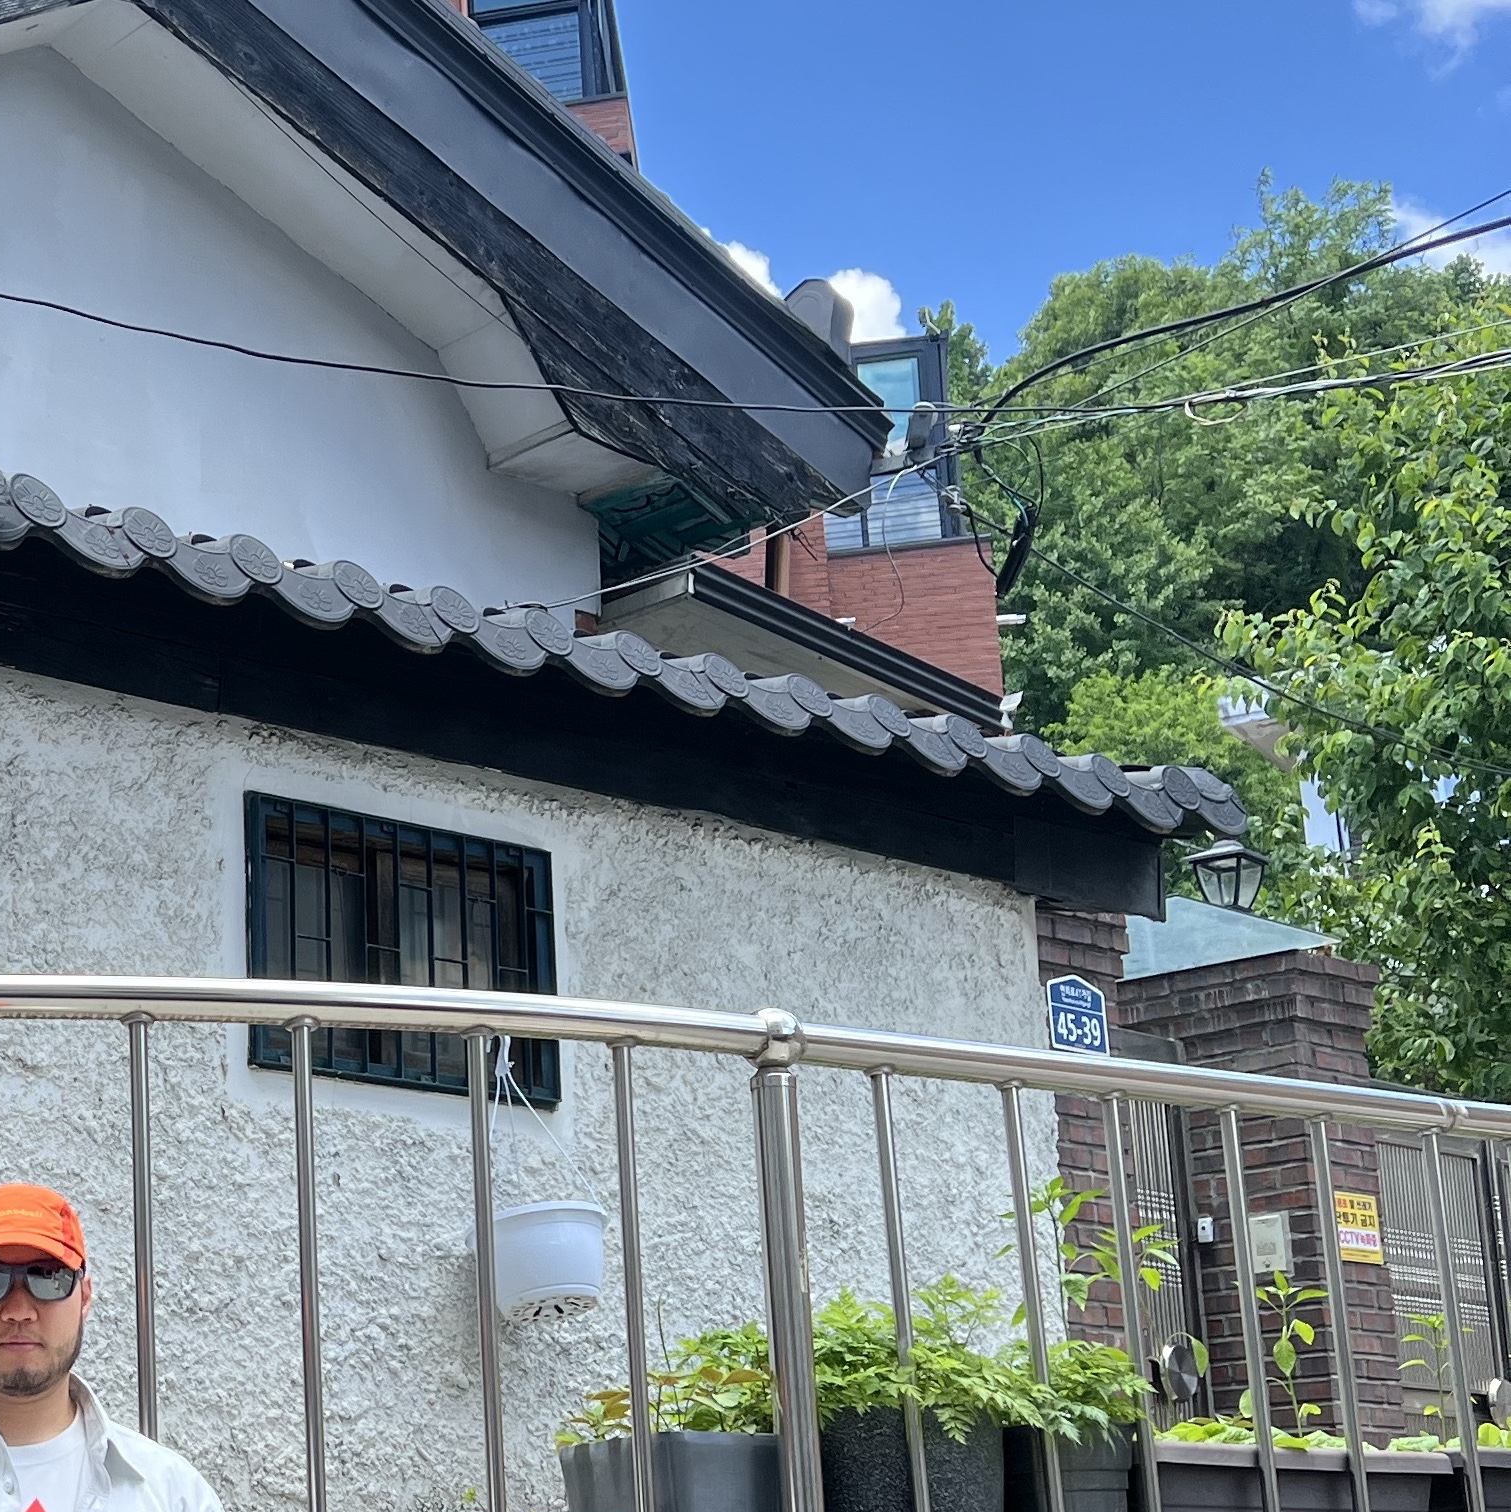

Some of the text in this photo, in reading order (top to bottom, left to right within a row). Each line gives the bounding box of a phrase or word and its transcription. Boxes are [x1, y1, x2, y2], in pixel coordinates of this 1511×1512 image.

[1057, 1011, 1101, 1046] 45-39
[1360, 1213, 1376, 1228] 금지
[1339, 1230, 1359, 1245] CCTV
